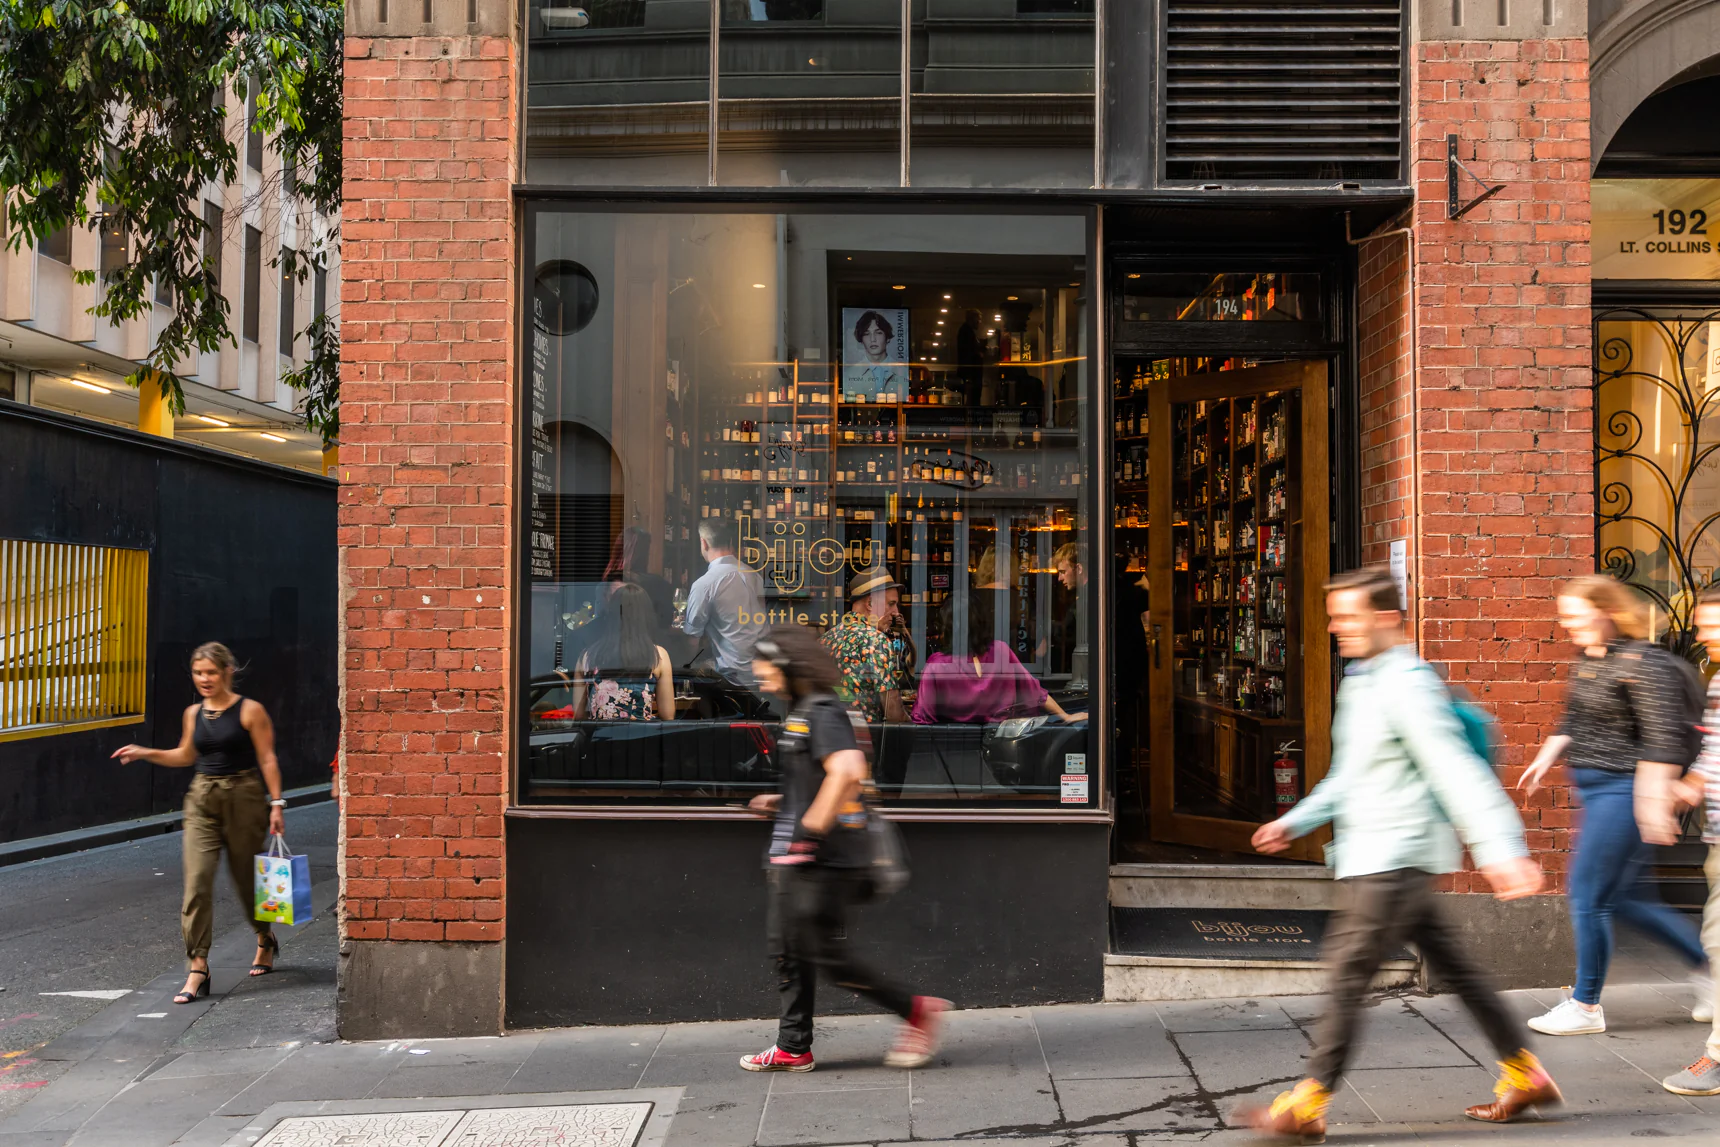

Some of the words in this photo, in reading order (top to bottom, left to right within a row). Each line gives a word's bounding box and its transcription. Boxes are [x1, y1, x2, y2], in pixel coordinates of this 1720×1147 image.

[1652, 209, 1707, 235] 192
[1620, 241, 1639, 253] LT.
[1645, 241, 1711, 253] COLLINS
[1215, 299, 1238, 315] 194
[738, 515, 882, 594] bijou
[738, 606, 809, 626] bottle
[819, 609, 879, 626] store
[1191, 920, 1303, 937] bijou
[1203, 935, 1259, 943] bottle
[1266, 936, 1312, 944] store
